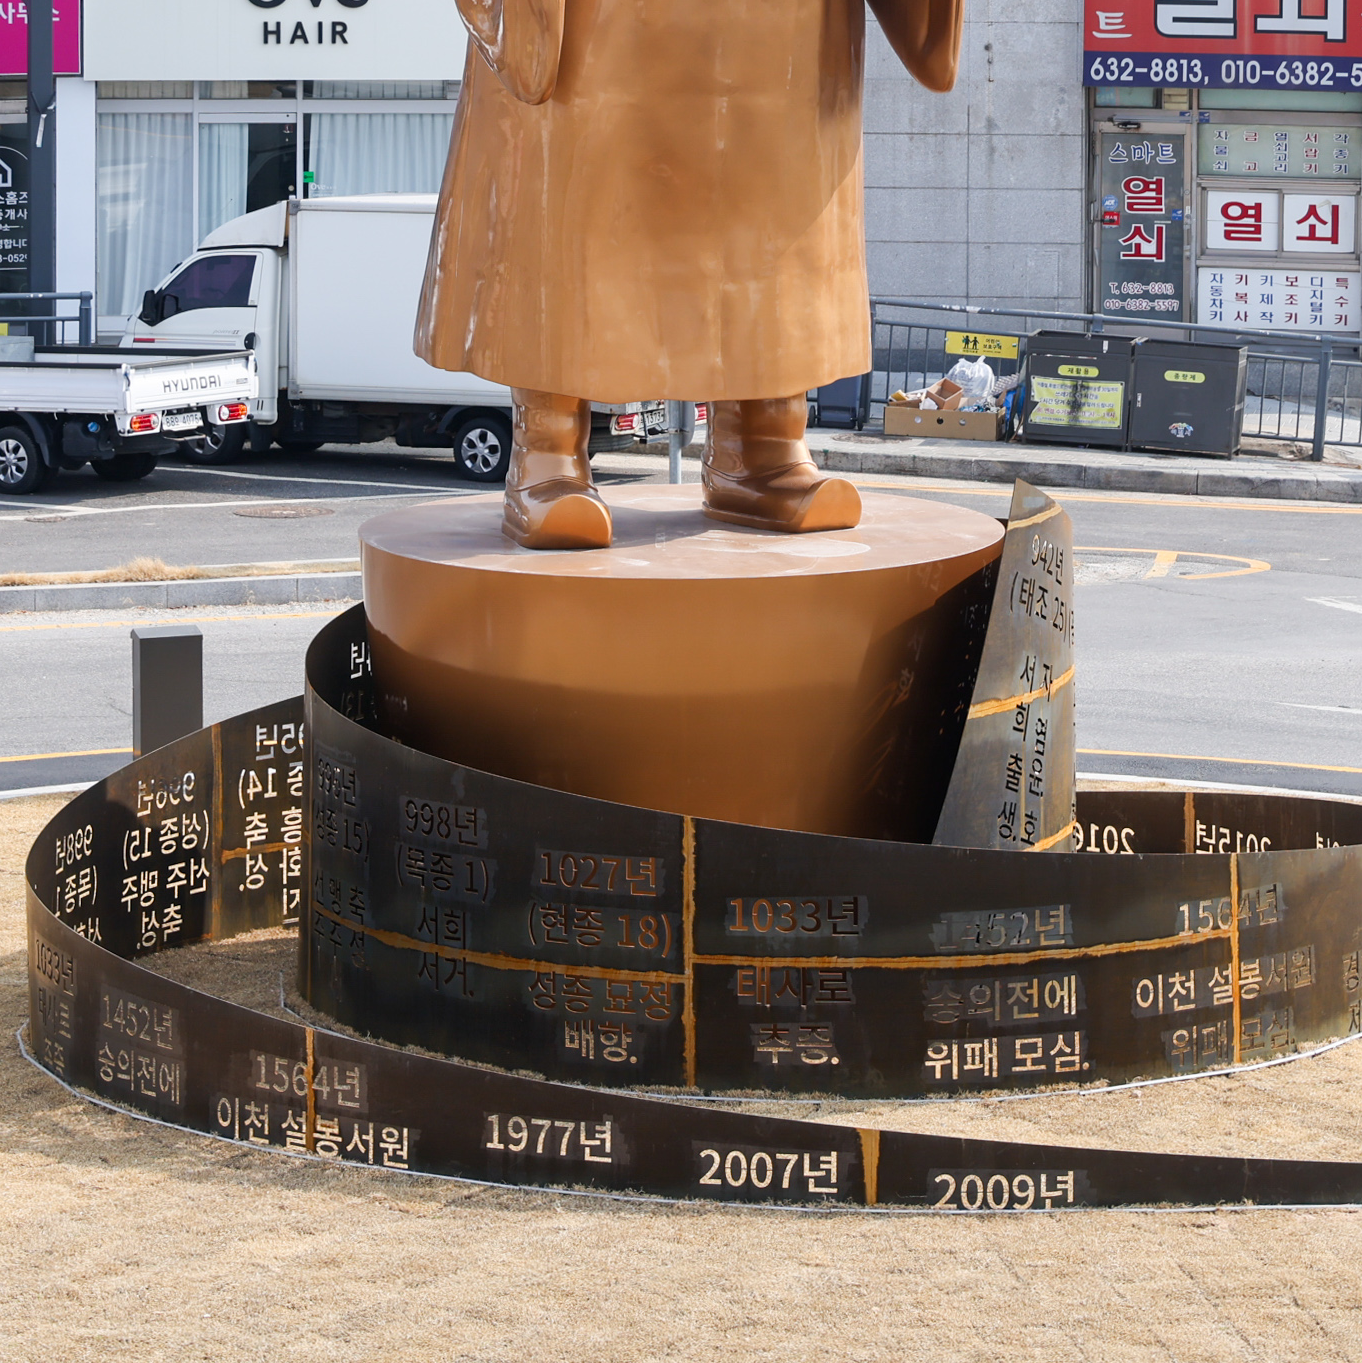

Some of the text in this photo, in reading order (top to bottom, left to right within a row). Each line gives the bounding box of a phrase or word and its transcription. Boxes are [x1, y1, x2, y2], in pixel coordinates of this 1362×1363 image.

[262, 21, 349, 45] HAIR
[1108, 140, 1177, 165] 스마트
[1213, 129, 1229, 172] 자물쇠
[1243, 130, 1259, 172] 금고
[1273, 131, 1288, 174] 열쇠고리
[1302, 132, 1319, 174] 서랍키
[1333, 133, 1349, 175] 각종키
[1118, 175, 1166, 262] 열쇠
[1220, 201, 1340, 245] 열쇠
[1104, 299, 1180, 312] 010-6382-5597
[1121, 281, 1175, 295] 632-8813
[1209, 272, 1224, 321] 자동차키
[1234, 273, 1249, 323] 키복사
[1259, 274, 1274, 323] 키제작
[1284, 275, 1299, 324] 보조키
[1309, 276, 1324, 325] 디지털키
[1334, 277, 1349, 326] 특수키
[162, 374, 222, 394] HYUNDAI
[404, 799, 479, 847] 998년
[540, 851, 658, 897] 1027년
[729, 895, 860, 937] 1033년
[1178, 882, 1279, 936] 1564년
[528, 969, 594, 1012] 성종
[736, 966, 853, 1010] 태사로
[927, 973, 1078, 1025] 숭의전에
[1135, 944, 1315, 1016] 이천 설봉서원
[102, 992, 175, 1050] 1452년
[97, 1041, 181, 1106] 숭의전에
[255, 1053, 362, 1110] 1564년
[924, 1036, 999, 1081] 위패
[216, 1096, 410, 1169] 이천 설봉서원
[484, 1113, 614, 1164] 1977년
[698, 1147, 838, 1194] 2007년
[933, 1169, 1076, 1210] 2009년
